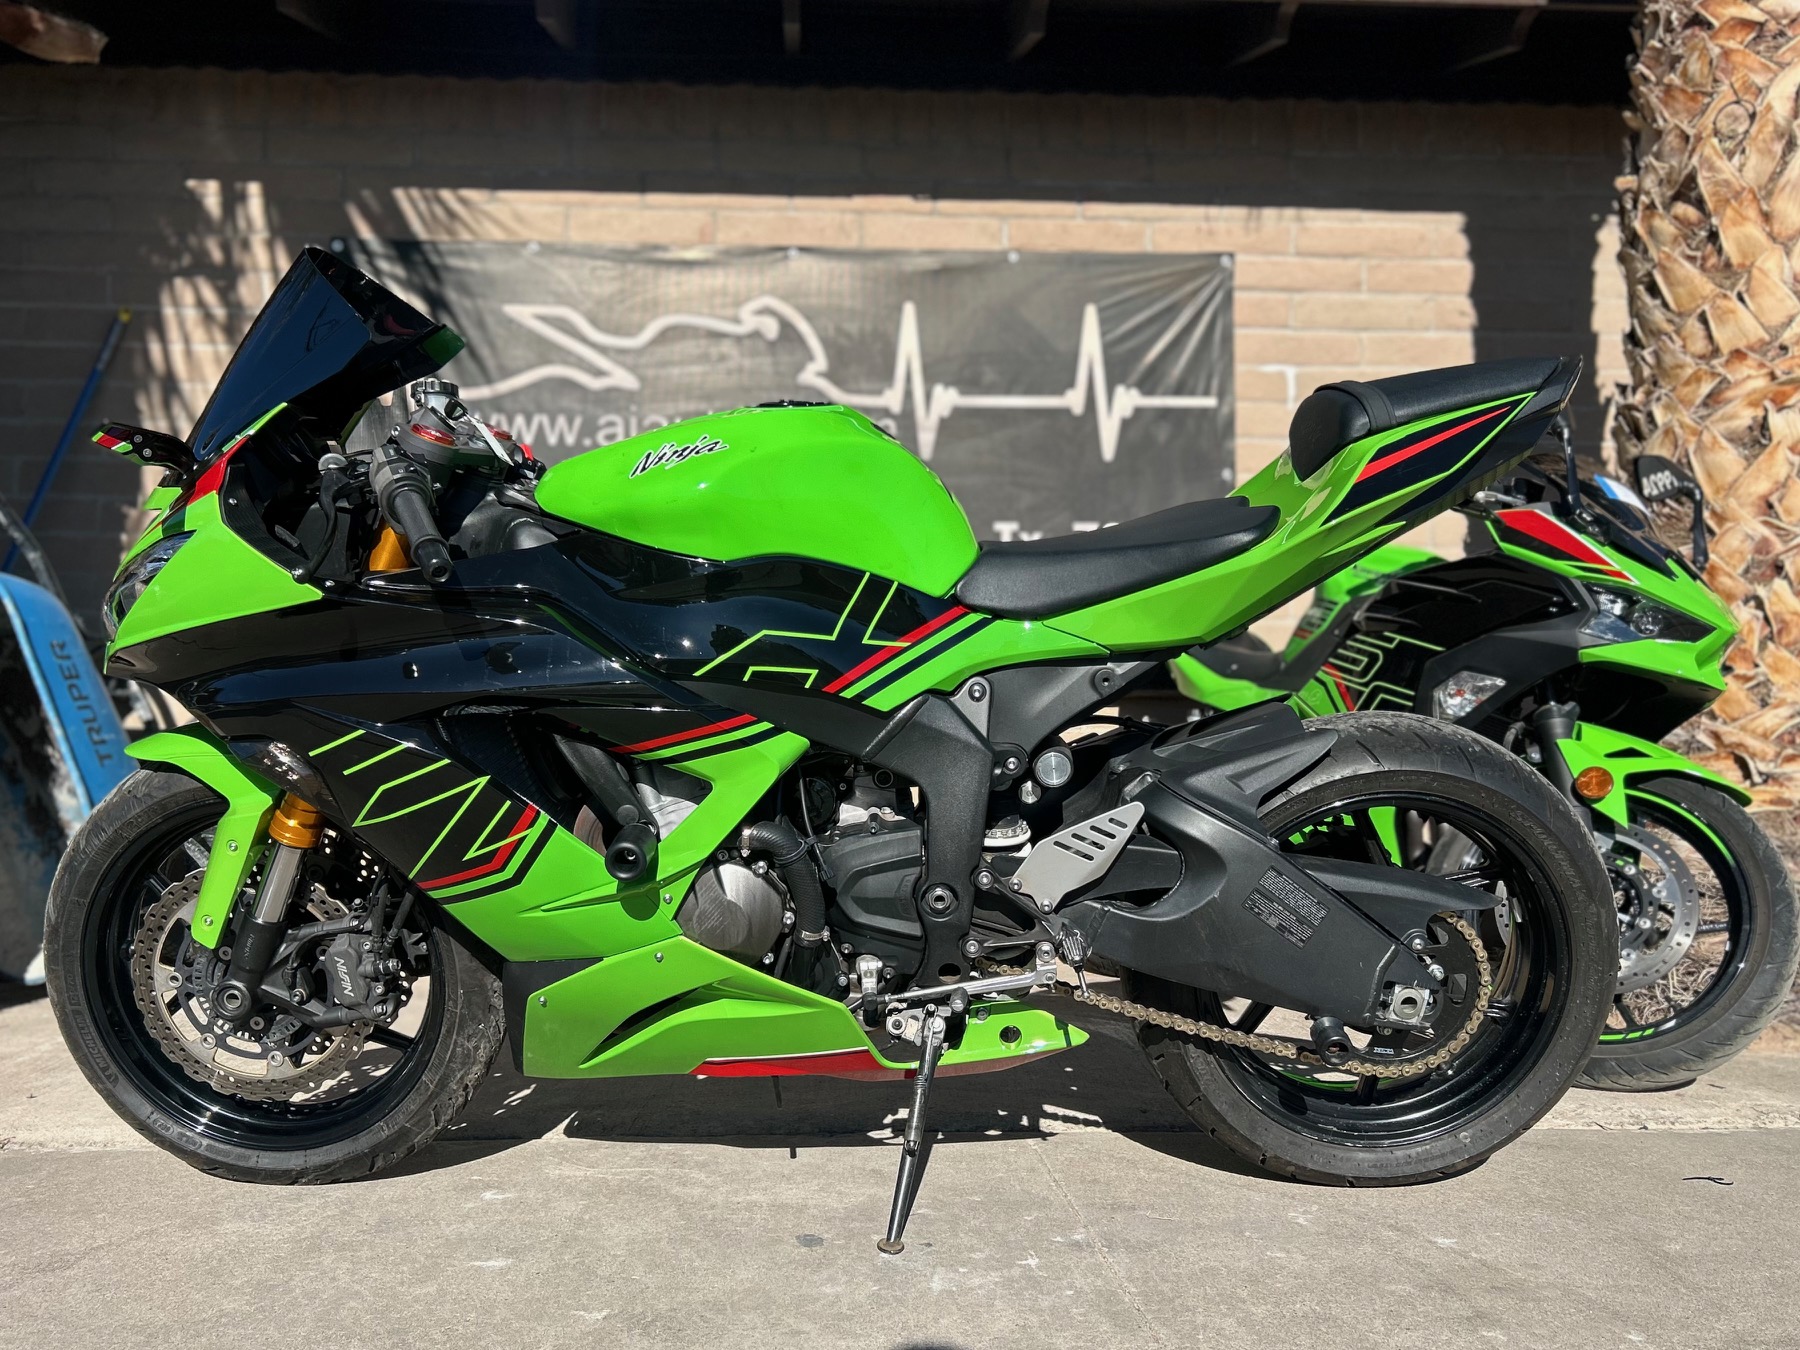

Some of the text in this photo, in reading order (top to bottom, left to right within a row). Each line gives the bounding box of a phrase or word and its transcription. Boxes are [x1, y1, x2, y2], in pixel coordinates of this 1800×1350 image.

[629, 434, 729, 479] Ninja
[50, 639, 113, 768] TRUPER
[75, 1013, 110, 1072] MICHELIN
